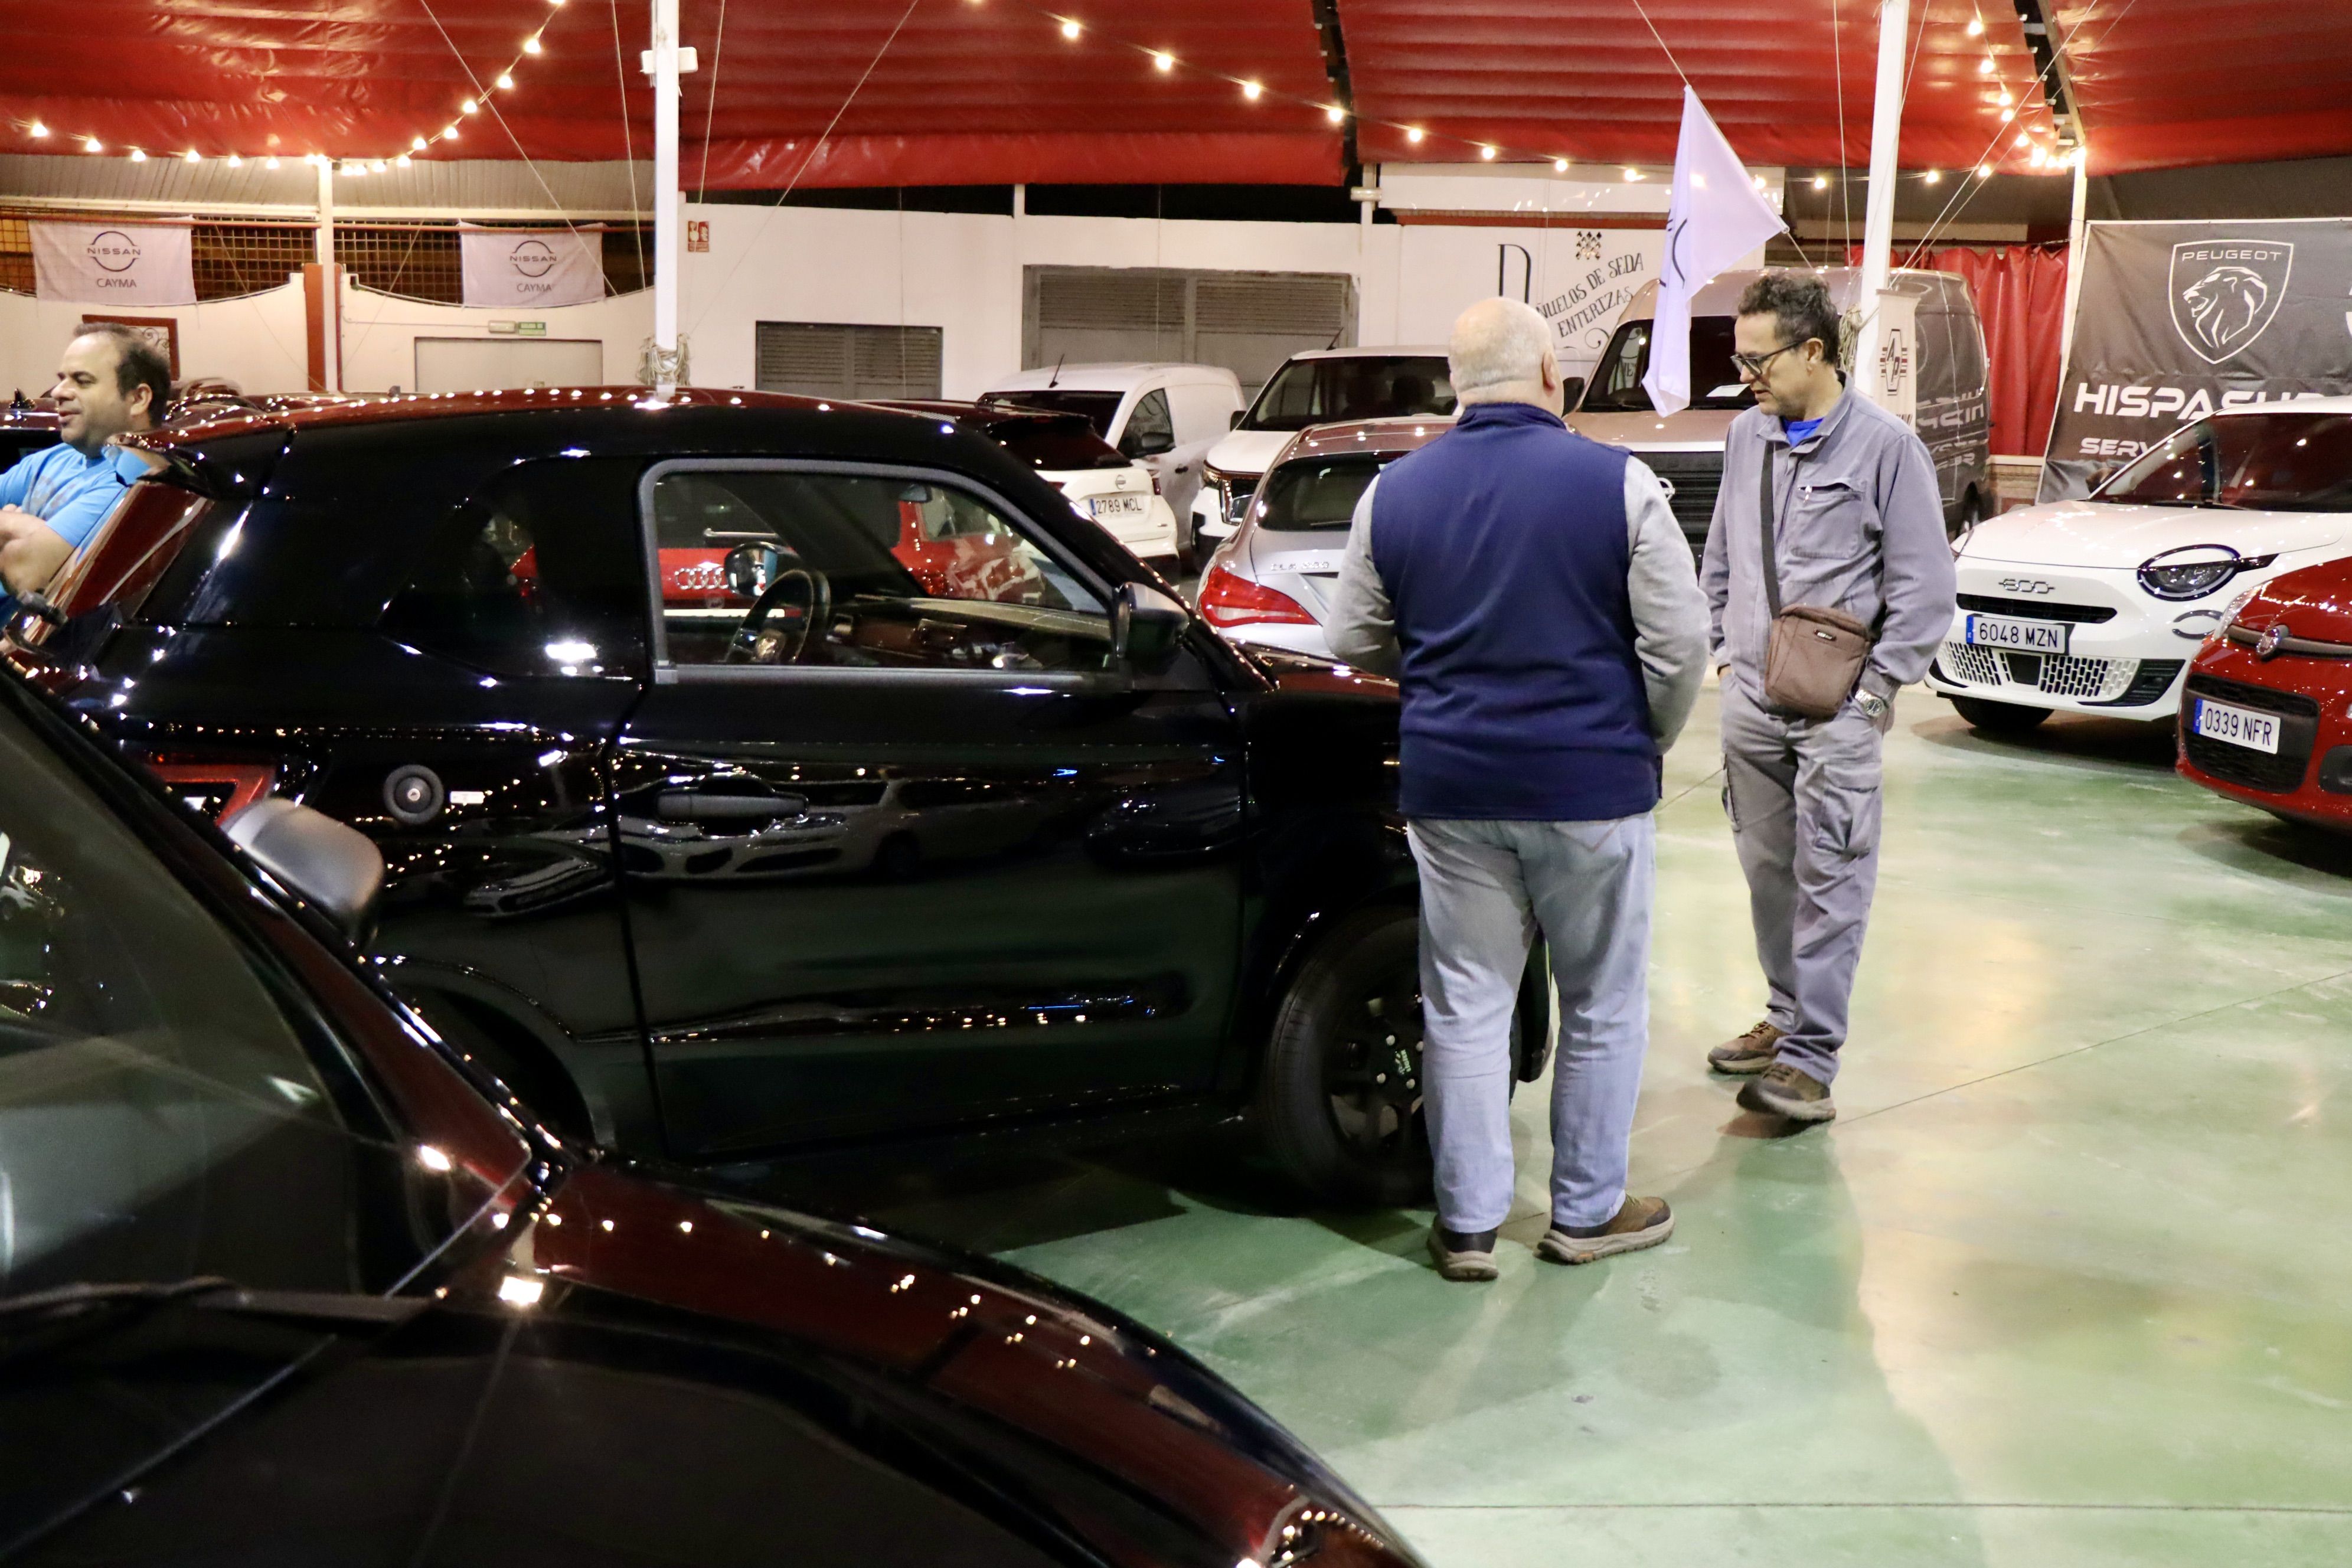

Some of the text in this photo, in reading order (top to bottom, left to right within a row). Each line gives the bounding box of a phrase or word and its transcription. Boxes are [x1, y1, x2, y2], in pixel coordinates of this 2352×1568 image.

[2182, 250, 2282, 261] PEUGEOT
[97, 278, 137, 288] CAYMA
[517, 284, 552, 292] CAYMA
[1536, 253, 1644, 319] ÑUELOS DE SEDA
[1557, 286, 1634, 338] ENTERIZAS
[2074, 383, 2324, 420] HISPAS
[1096, 498, 1142, 514] 2789 MCL
[1979, 623, 2058, 648] 6048 MZN
[2206, 708, 2272, 746] 0339 NFR
